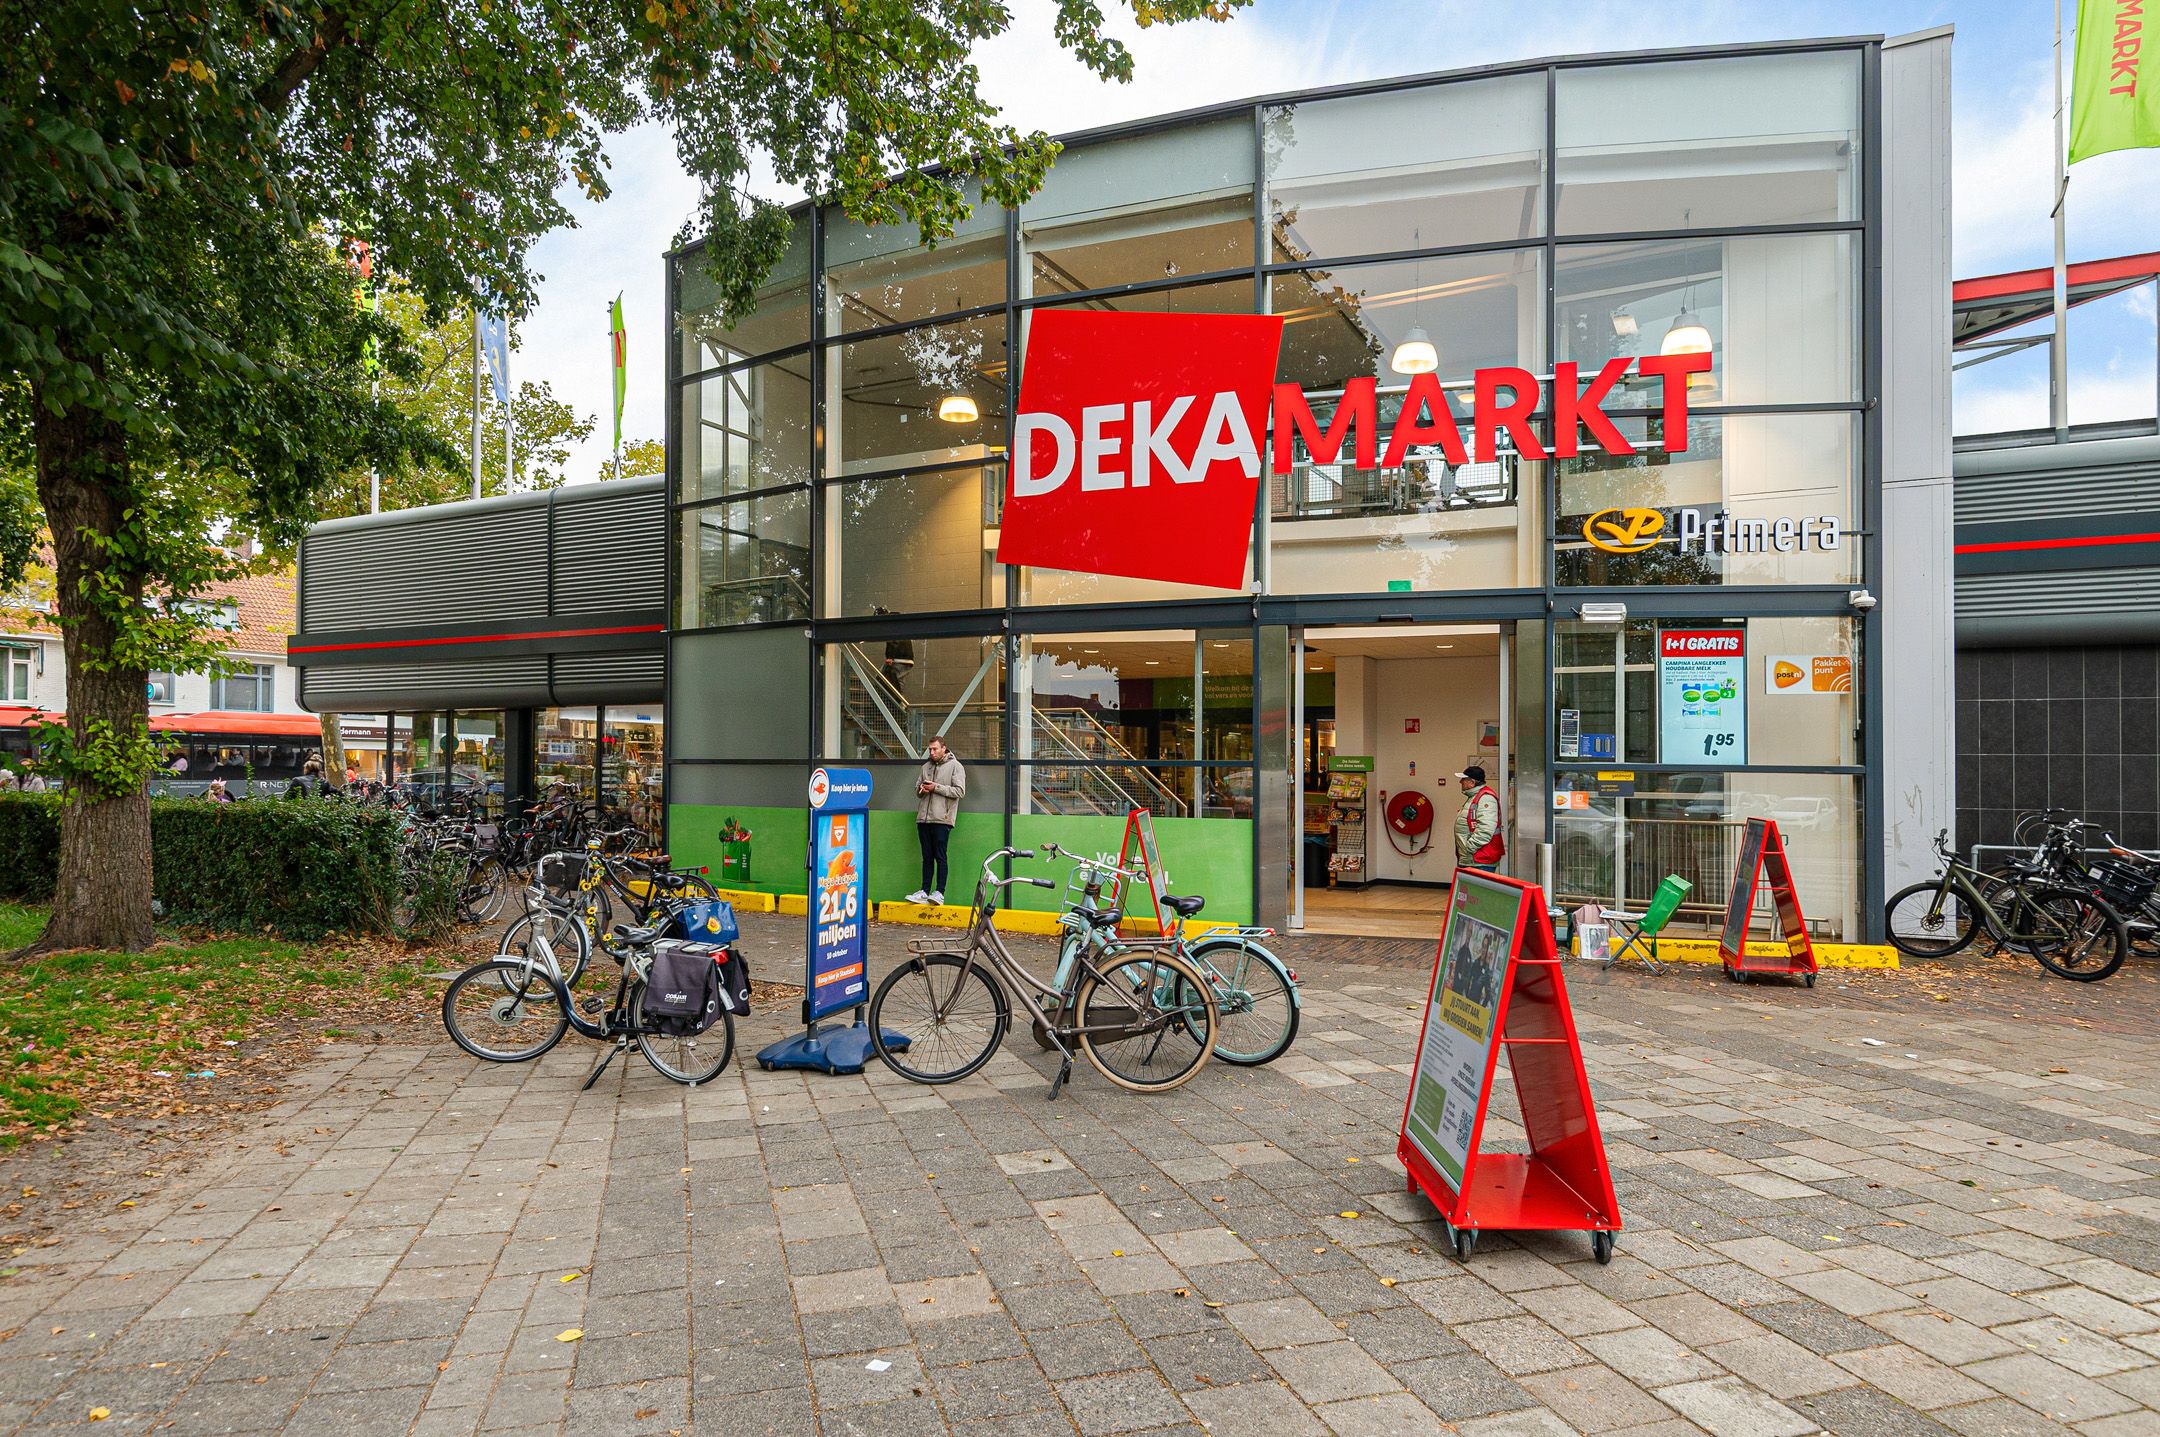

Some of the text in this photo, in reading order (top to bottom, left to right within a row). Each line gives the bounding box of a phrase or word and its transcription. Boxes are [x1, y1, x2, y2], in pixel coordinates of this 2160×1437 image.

[1679, 508, 1841, 554] Primera
[1666, 637, 1739, 650] 1+1 GRATIS
[1814, 659, 1841, 667] Pakket
[1814, 667, 1833, 675] punt
[831, 784, 842, 794] Koop
[842, 783, 851, 792] hier
[851, 783, 857, 794] je
[819, 886, 858, 924] 21,6
[818, 923, 857, 947] miljoen
